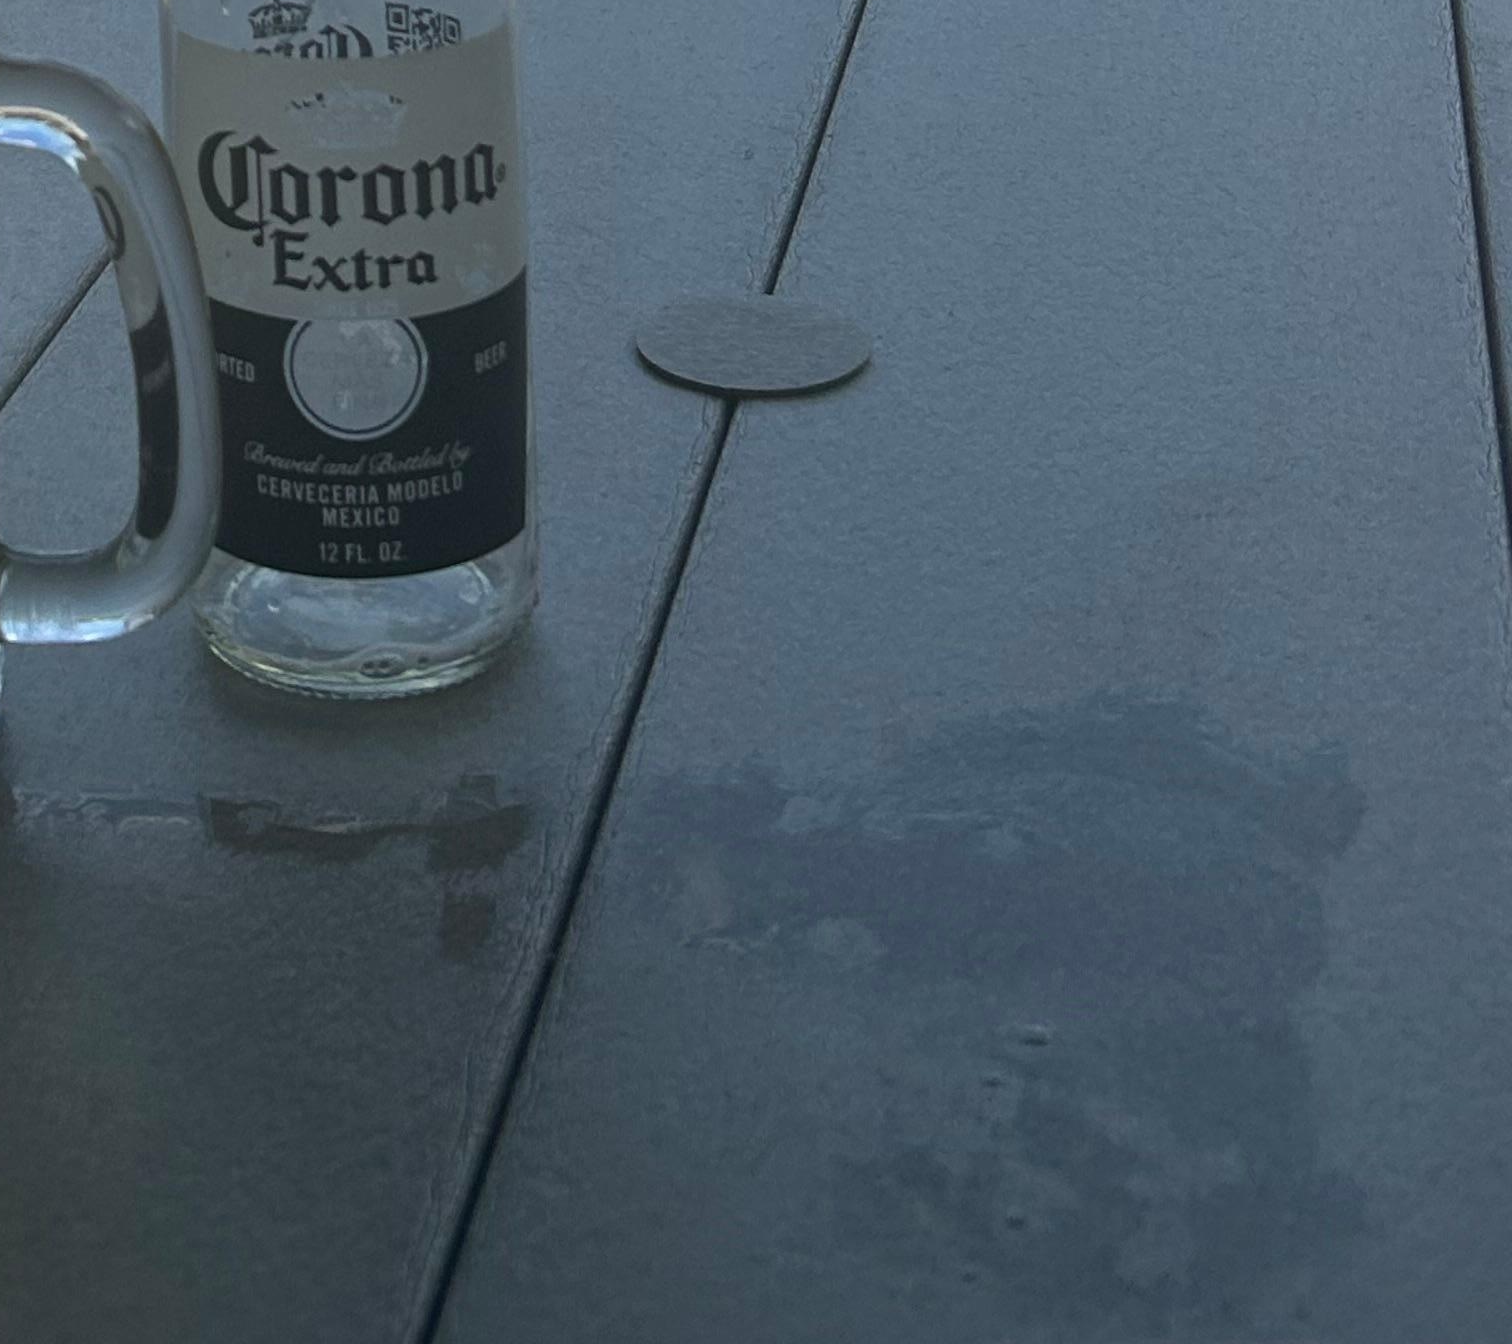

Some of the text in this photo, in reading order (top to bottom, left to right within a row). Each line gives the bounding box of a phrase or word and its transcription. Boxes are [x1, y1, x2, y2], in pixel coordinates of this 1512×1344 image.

[269, 229, 439, 292] Extra
[216, 352, 256, 382] RTED
[474, 341, 507, 374] BEER
[244, 440, 472, 476] Brewed and Bottled by
[257, 470, 463, 505] CERVECERIA MODELO
[322, 505, 400, 529] MEXICO
[319, 541, 338, 563] 12
